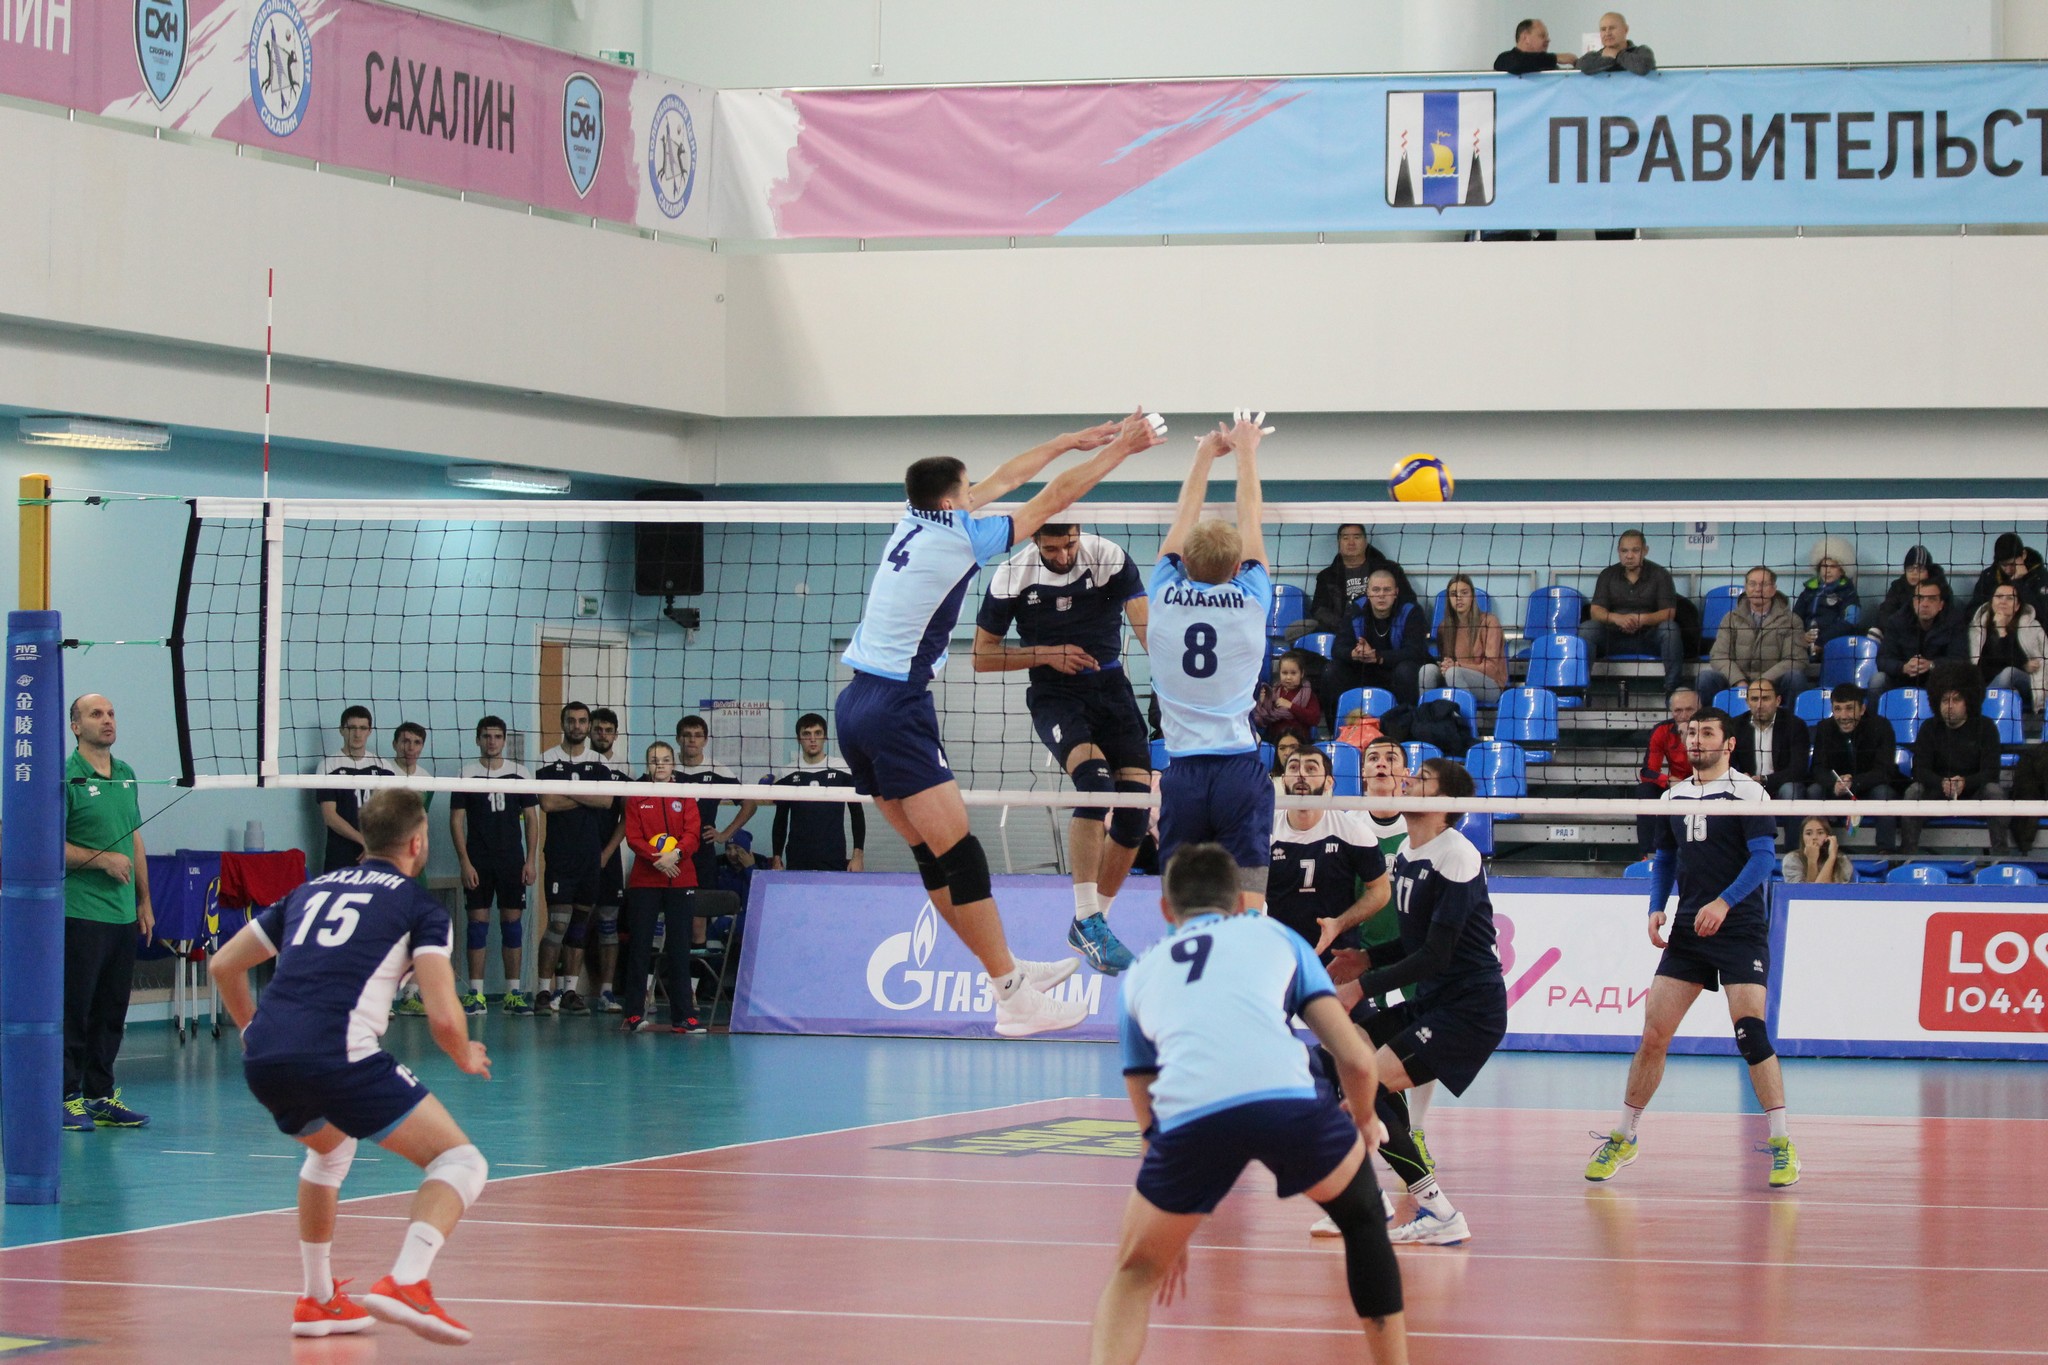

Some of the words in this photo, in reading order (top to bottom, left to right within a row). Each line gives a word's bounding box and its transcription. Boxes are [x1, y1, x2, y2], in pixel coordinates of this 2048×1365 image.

[365, 50, 515, 154] САХАЛИН
[260, 107, 298, 135] САХАЛИН
[887, 524, 923, 573] 4
[1163, 586, 1244, 609] САХАЛИН
[15, 644, 38, 654] FIVB
[1182, 622, 1218, 679] 8
[15, 692, 34, 782] 金陵体育
[1555, 828, 1568, 837] РЯД
[1683, 815, 1708, 842] 15
[1325, 842, 1339, 854] ДГУ
[1299, 858, 1316, 888] 7
[1384, 853, 1397, 882] 2
[1396, 876, 1414, 914] 17
[291, 891, 374, 947] 15
[1170, 934, 1214, 984] 9
[933, 971, 1104, 1015] ГАЗМ
[1945, 986, 2046, 1015] 104.4
